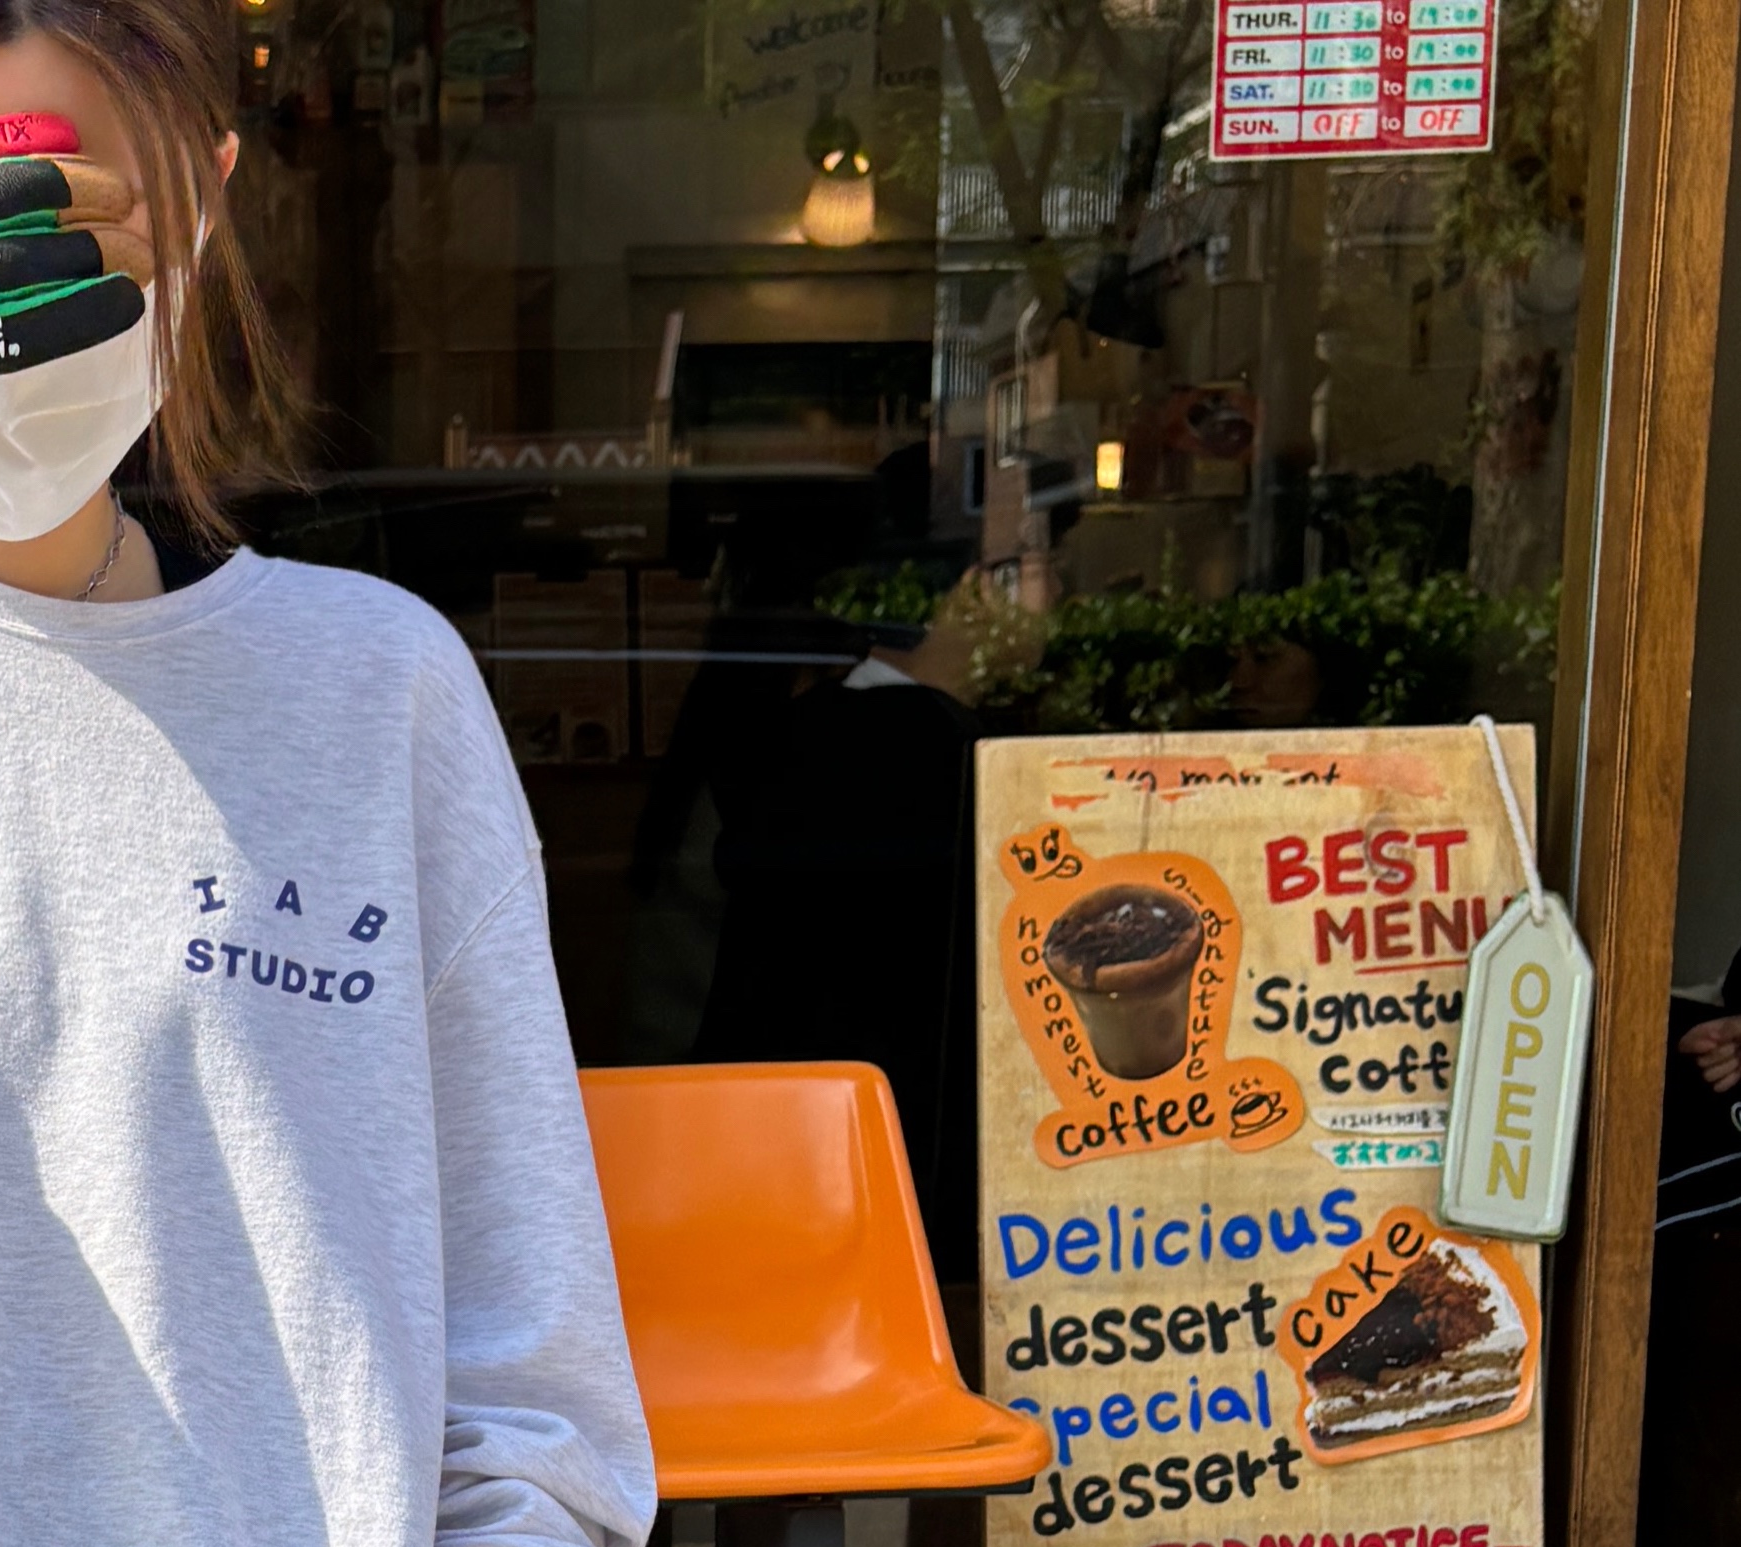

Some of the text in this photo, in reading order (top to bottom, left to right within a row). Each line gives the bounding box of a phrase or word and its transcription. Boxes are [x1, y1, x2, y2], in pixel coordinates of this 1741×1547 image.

[1233, 12, 1298, 30] THUR.
[1386, 10, 1406, 26] to
[1231, 48, 1272, 66] FRI.
[1384, 44, 1404, 60] to
[1228, 118, 1280, 137] SUN.
[1381, 115, 1401, 132] to
[1419, 108, 1465, 133] OFF
[1229, 83, 1275, 101] SAT.
[1383, 80, 1403, 95] to
[1264, 829, 1468, 905] BEST
[184, 938, 376, 1004] STUDIO
[1252, 976, 1464, 1045] Signatu
[1319, 1041, 1452, 1094] coff
[1485, 962, 1553, 1202] OPEN
[1055, 1090, 1216, 1158] coffee
[998, 1187, 1363, 1281] Delicious
[1005, 1282, 1279, 1372] dessert
[1031, 1436, 1304, 1537] dessert
